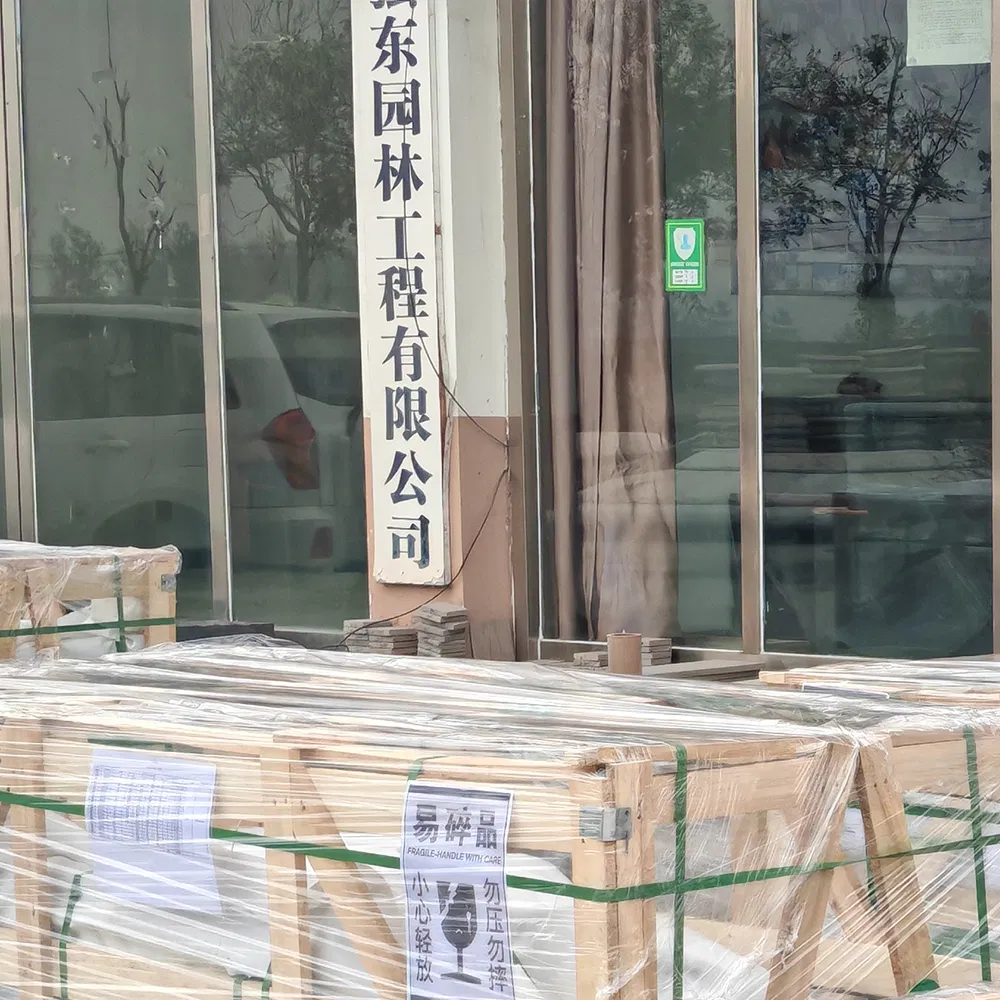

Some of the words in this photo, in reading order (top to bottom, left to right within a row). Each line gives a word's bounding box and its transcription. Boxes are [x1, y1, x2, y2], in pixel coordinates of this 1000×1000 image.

[370, 0, 433, 569] 东园林工程有限公司
[407, 847, 464, 861] FRAGILE-HANDLE
[465, 853, 483, 863] WITH
[484, 856, 502, 865] CARE
[413, 804, 498, 849] 易碎品
[412, 871, 434, 983] 小心轻放
[483, 878, 509, 992] 勿压勿摔
